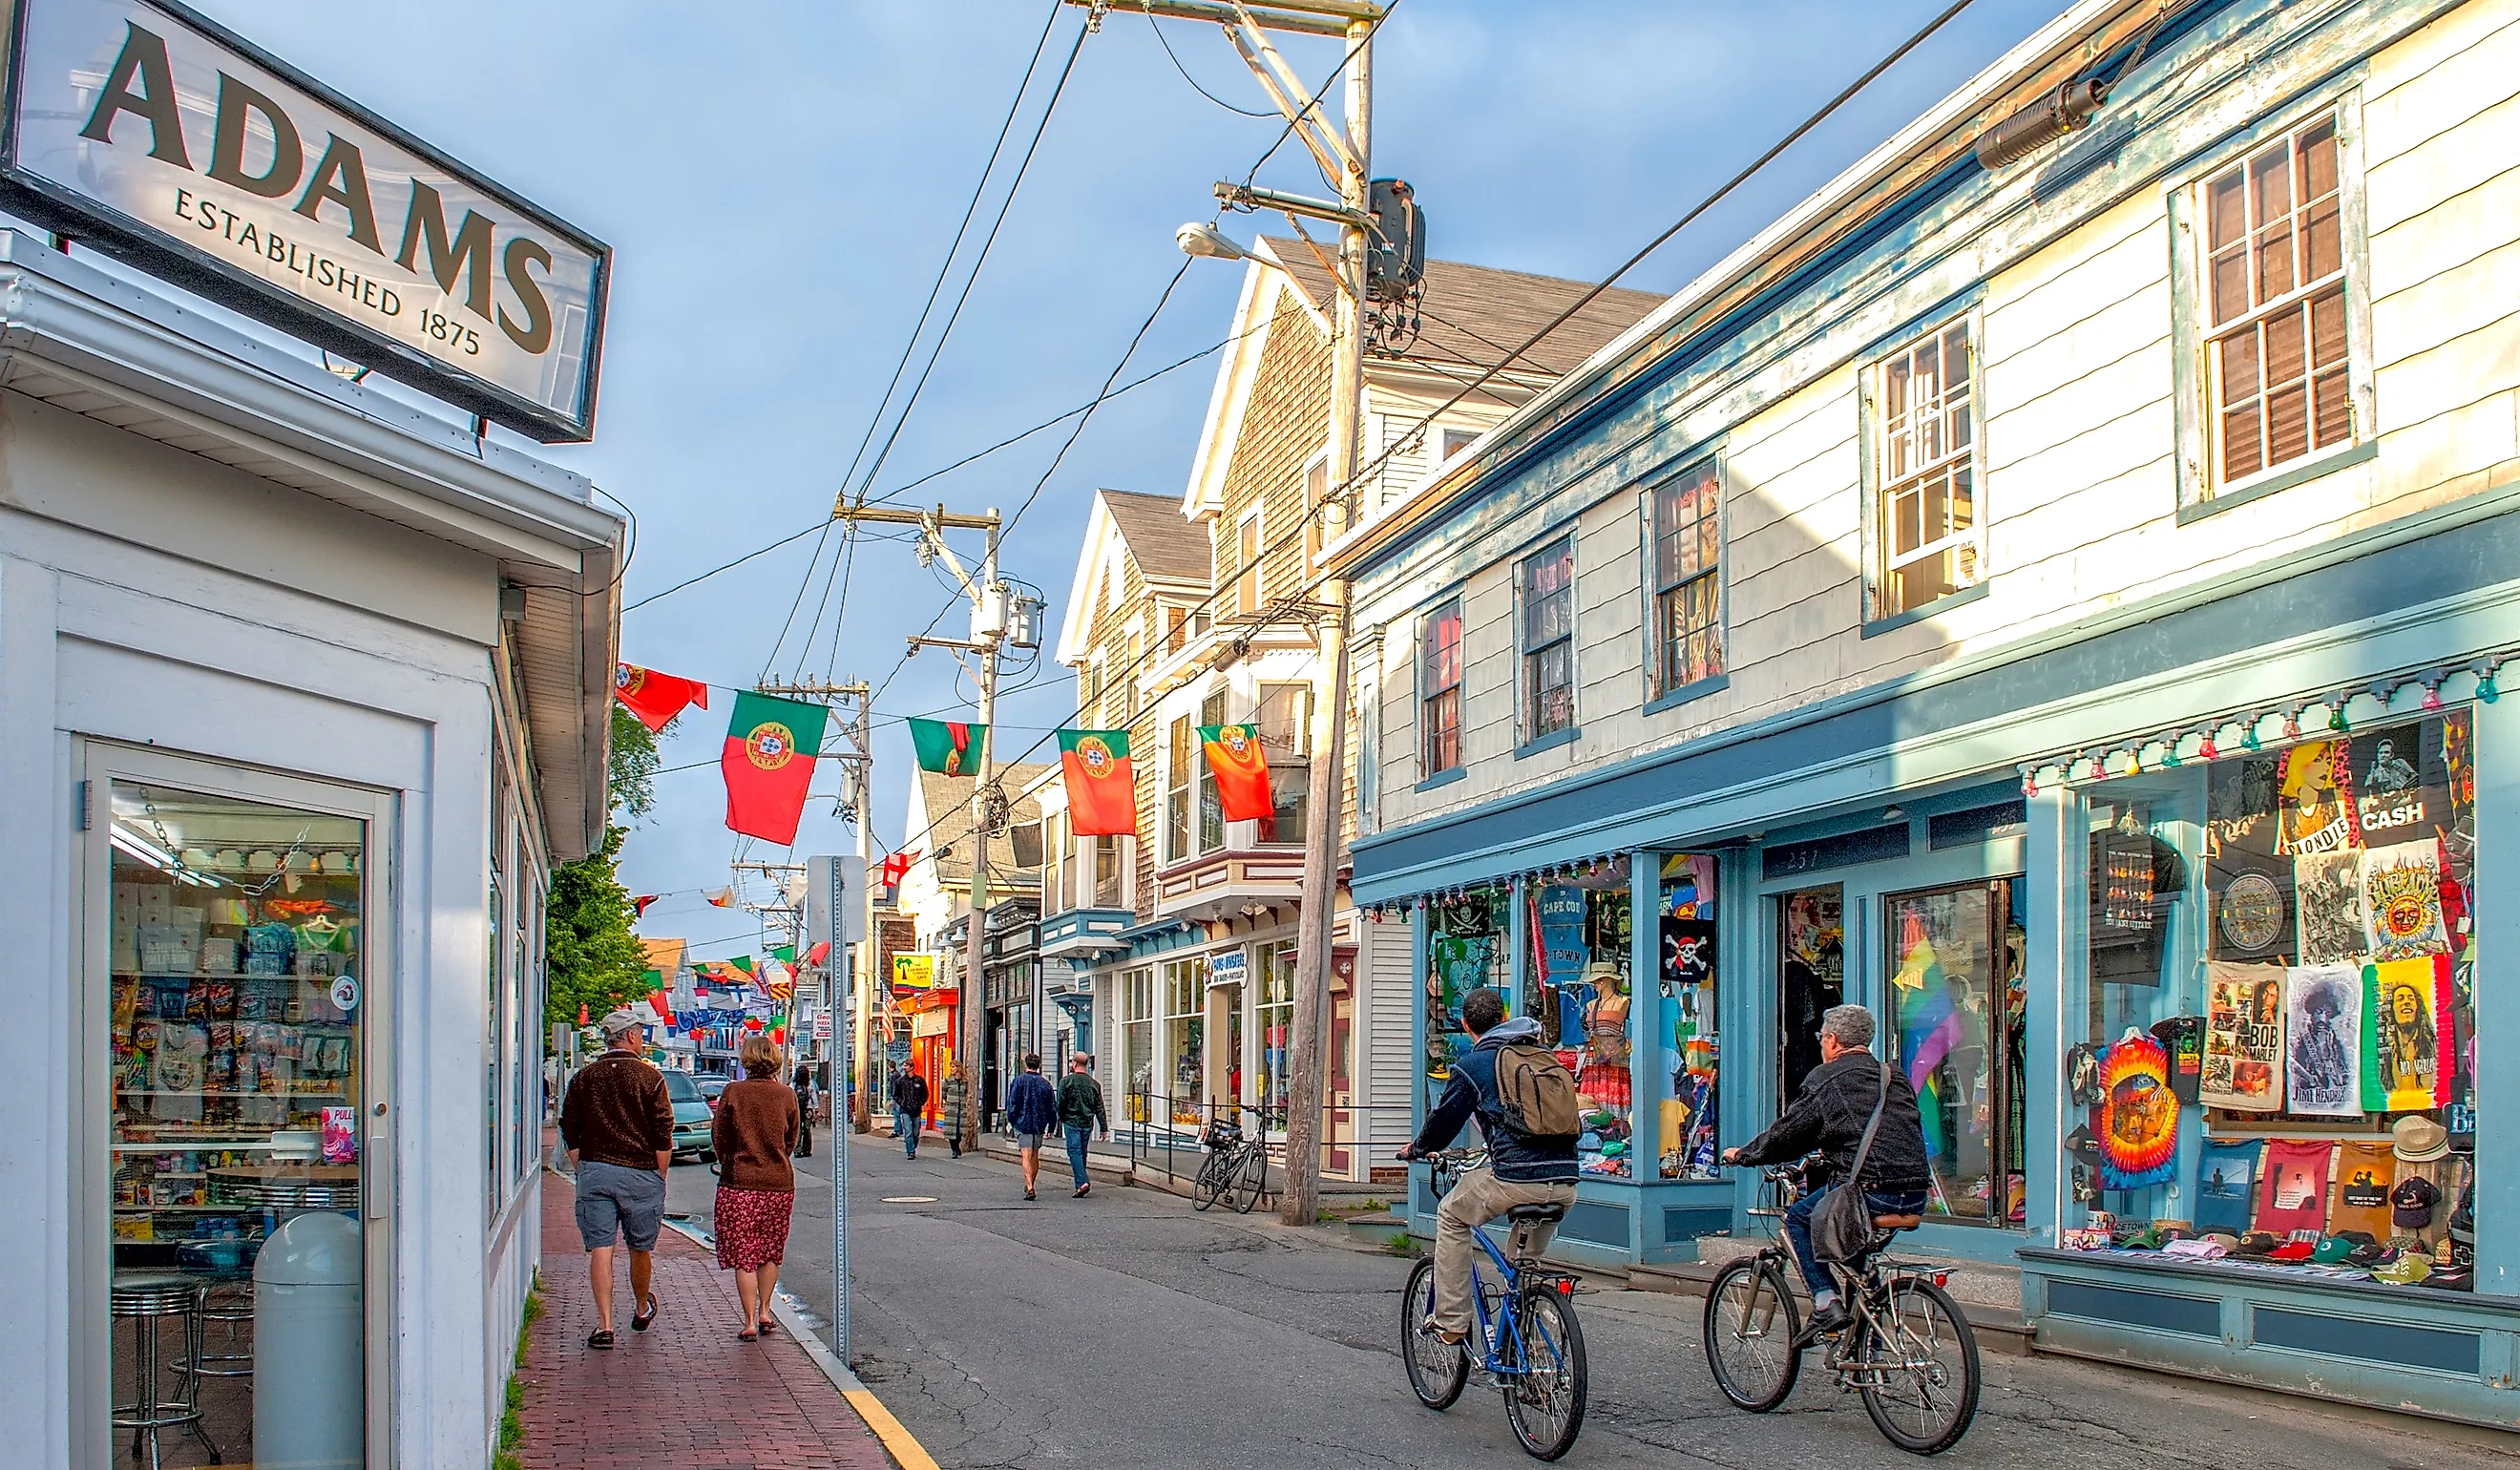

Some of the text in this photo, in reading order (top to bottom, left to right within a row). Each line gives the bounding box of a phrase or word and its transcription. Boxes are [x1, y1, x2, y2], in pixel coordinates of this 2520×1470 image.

[78, 18, 553, 354] ADAMS
[175, 188, 480, 355] ESTABLISHED 1875
[2362, 802, 2425, 831] CASH
[1544, 900, 1564, 915] CAPE
[2250, 1023, 2278, 1048] BOB
[2249, 1048, 2278, 1062] MARLEY
[2292, 1085, 2345, 1103] JIMI HENDRIX
[334, 1109, 353, 1121] PULL
[2113, 1222, 2151, 1233] CETOWN
